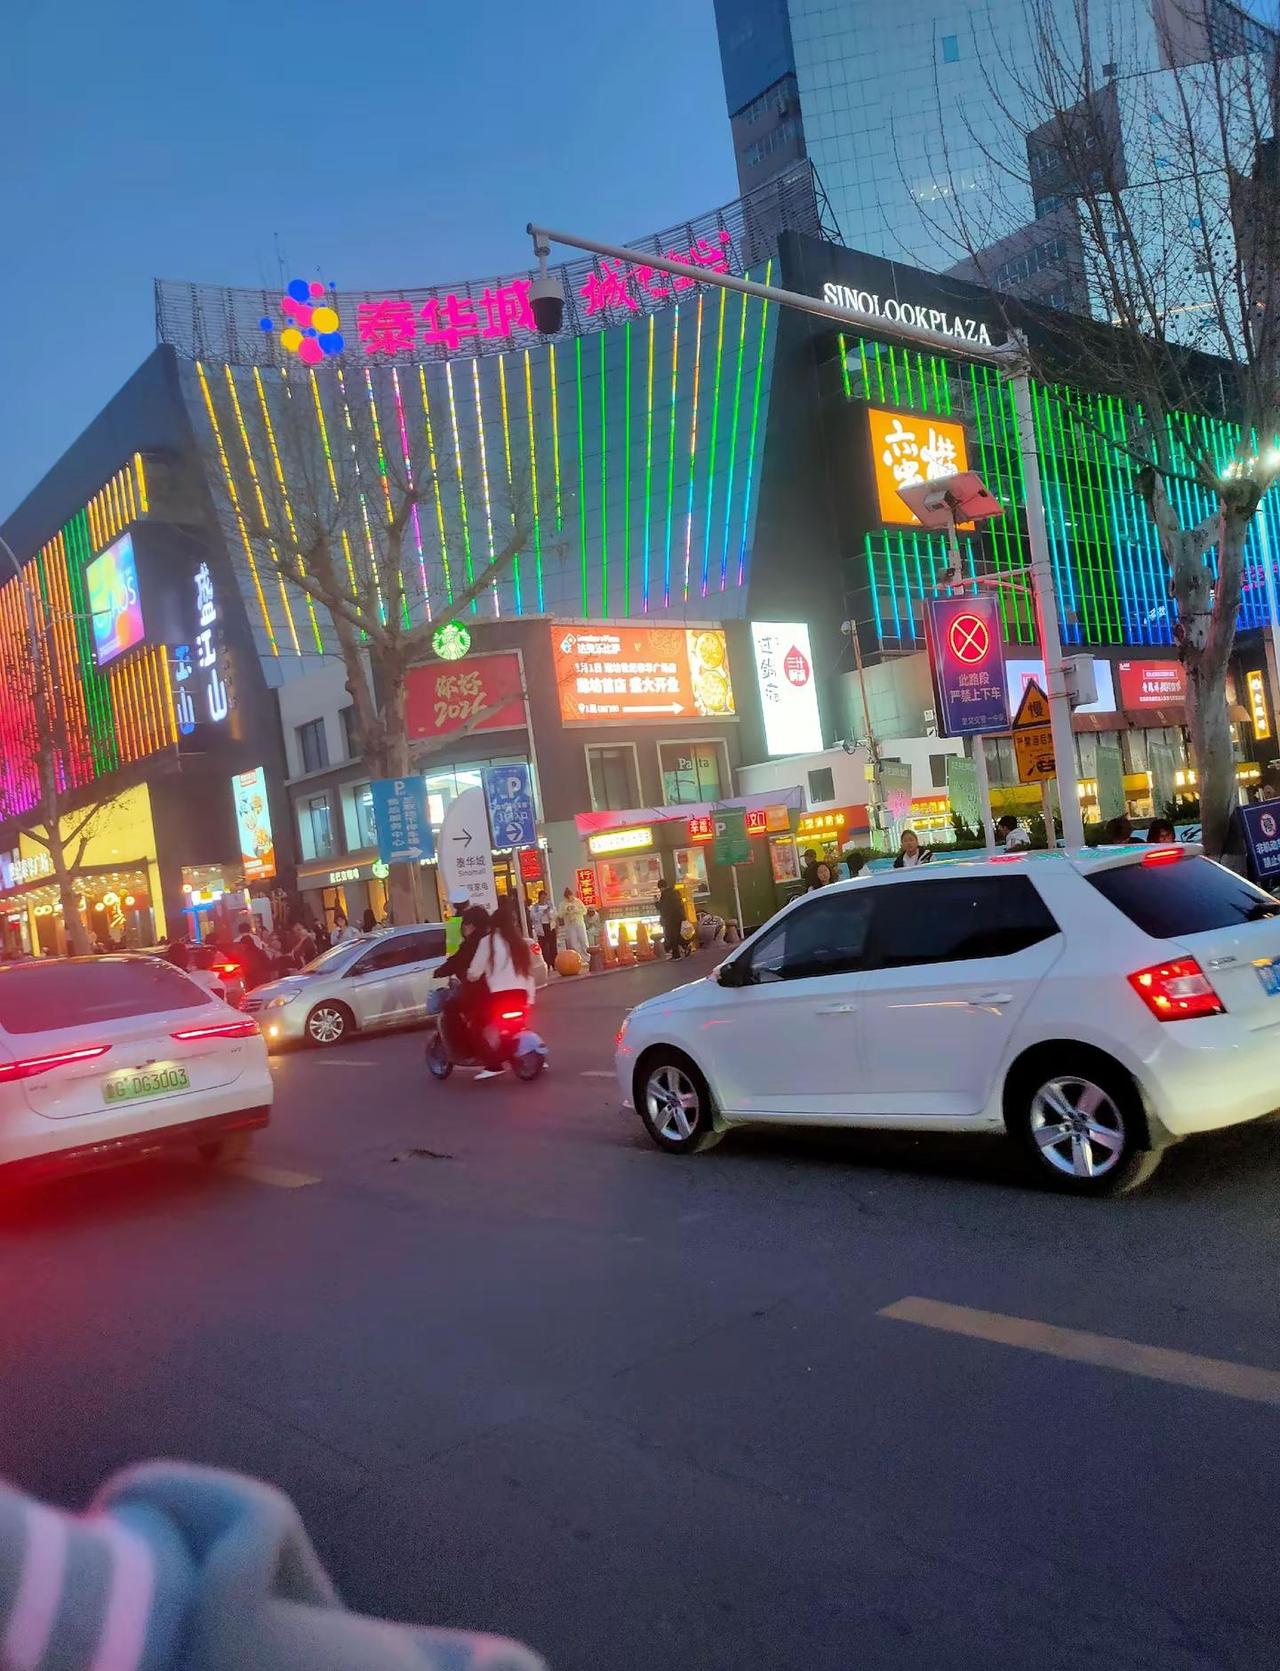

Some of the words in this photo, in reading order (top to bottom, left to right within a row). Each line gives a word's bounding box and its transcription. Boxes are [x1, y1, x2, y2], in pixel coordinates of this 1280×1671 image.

[357, 278, 537, 354] 泰华城
[435, 671, 482, 699] 你好
[958, 671, 991, 687] 此路段
[949, 686, 1002, 704] 严禁上下车
[1028, 700, 1044, 719] 慢
[394, 781, 405, 796] P
[507, 777, 522, 799] P
[715, 822, 727, 836] P
[456, 855, 486, 868] 泰华城
